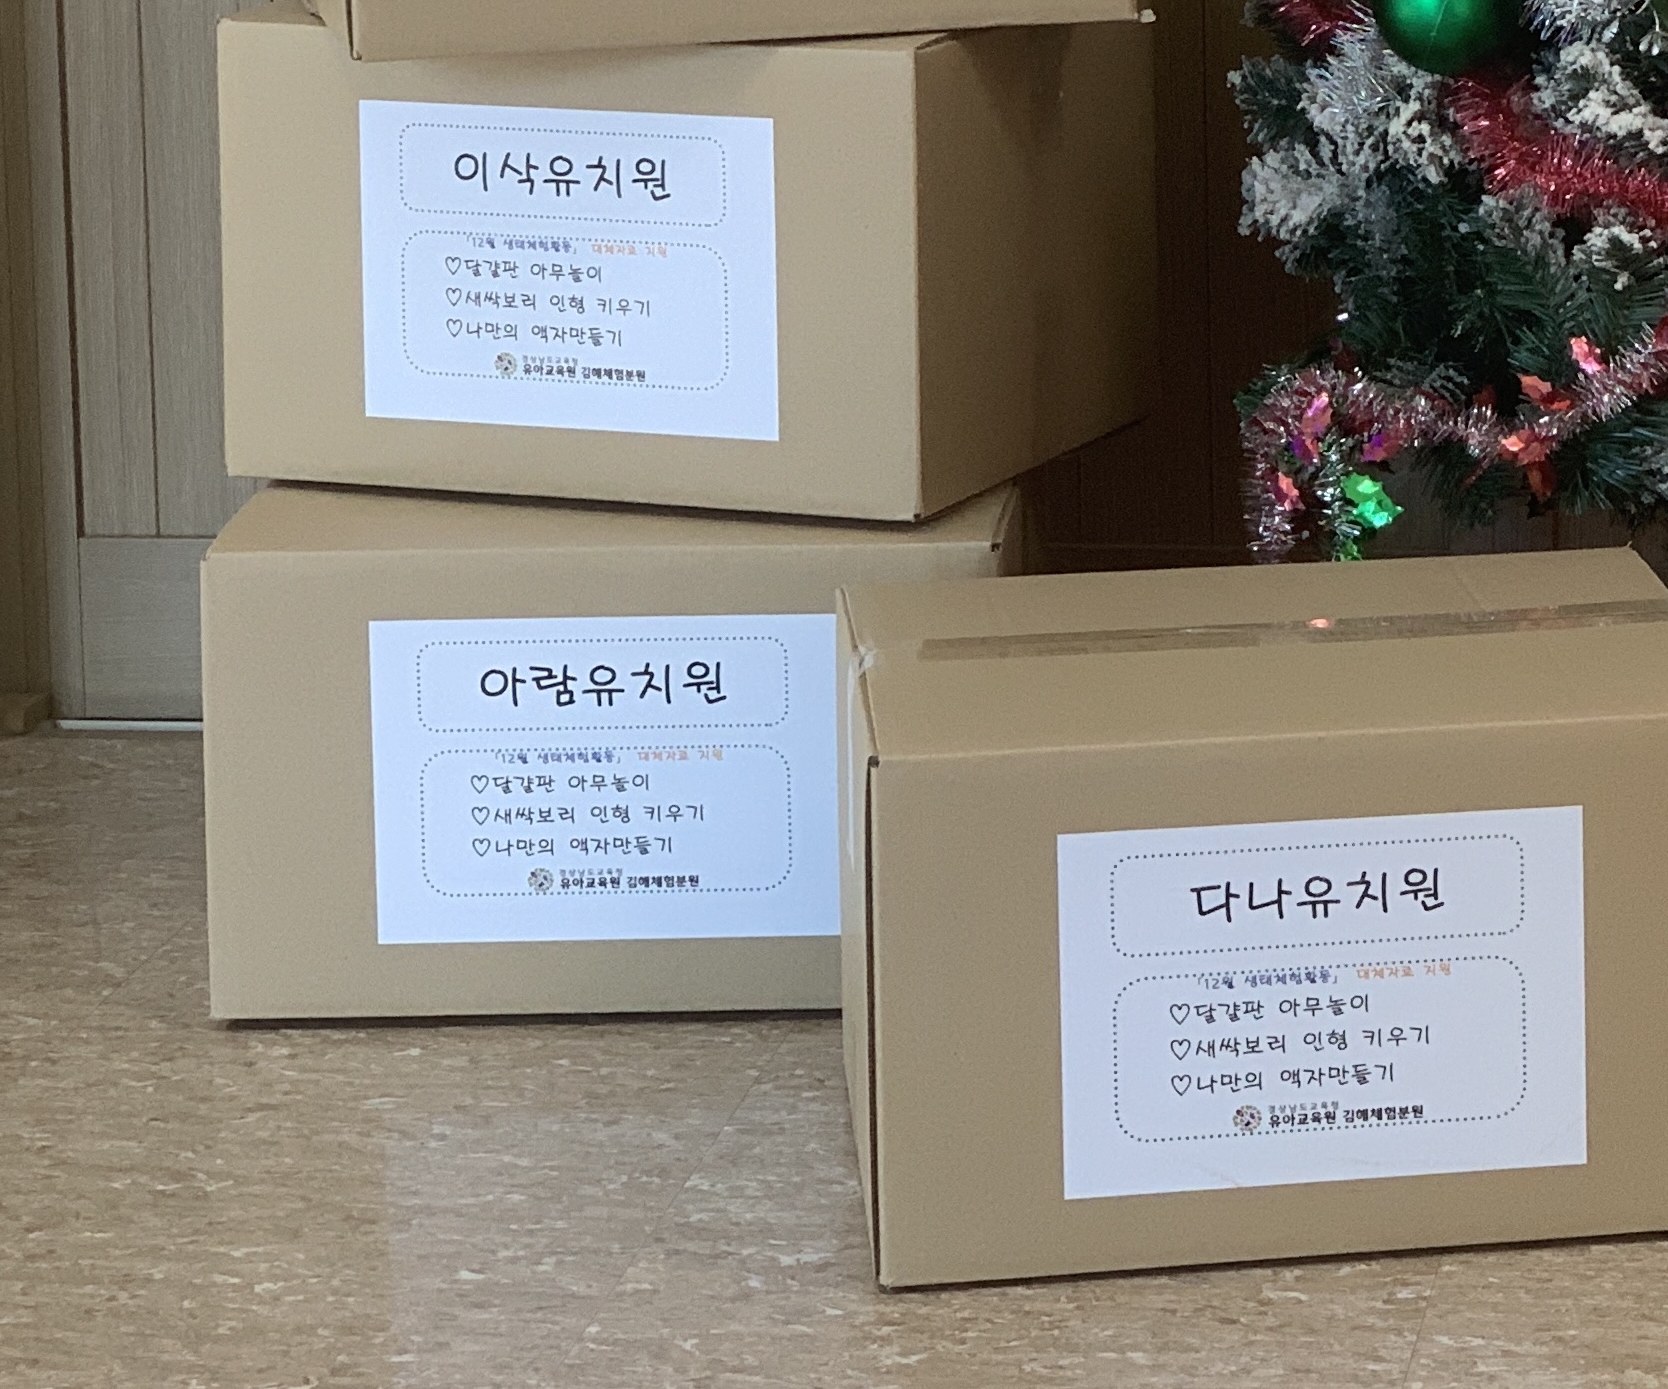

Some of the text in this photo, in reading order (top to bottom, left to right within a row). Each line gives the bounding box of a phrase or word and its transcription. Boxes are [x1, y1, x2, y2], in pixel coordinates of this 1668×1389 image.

[454, 152, 671, 201] 이삭유치원
[592, 243, 637, 256] 대체자료
[646, 246, 668, 258] 지원
[464, 258, 603, 283] 달걀판 아무놀이
[465, 290, 650, 317] 새싹보리 인형 키우기
[466, 322, 622, 347] 나만의 액자만들기
[523, 364, 646, 382] 유아교육원 김해체험분원
[480, 660, 727, 707] 아람유치원
[638, 749, 689, 761] 대체자료
[699, 749, 723, 761] 지원
[492, 774, 650, 794] 달걀판 아무놀이
[494, 805, 705, 825] 새싹보리 인형 키우기
[496, 836, 673, 856] 나만의 액자만들기
[560, 874, 700, 889] 유아교육원 김해체험분원
[1191, 867, 1444, 923] 다나유치원
[1356, 966, 1414, 980] 대체자료
[1424, 964, 1452, 976] 지원
[1194, 995, 1369, 1024] 달걀판 아무놀이
[1195, 1026, 1430, 1056] 새싹보리 인형 키우기
[1197, 1064, 1394, 1094] 나만의 액자만들기
[1269, 1104, 1424, 1129] 유아교육원 김해체험분원
